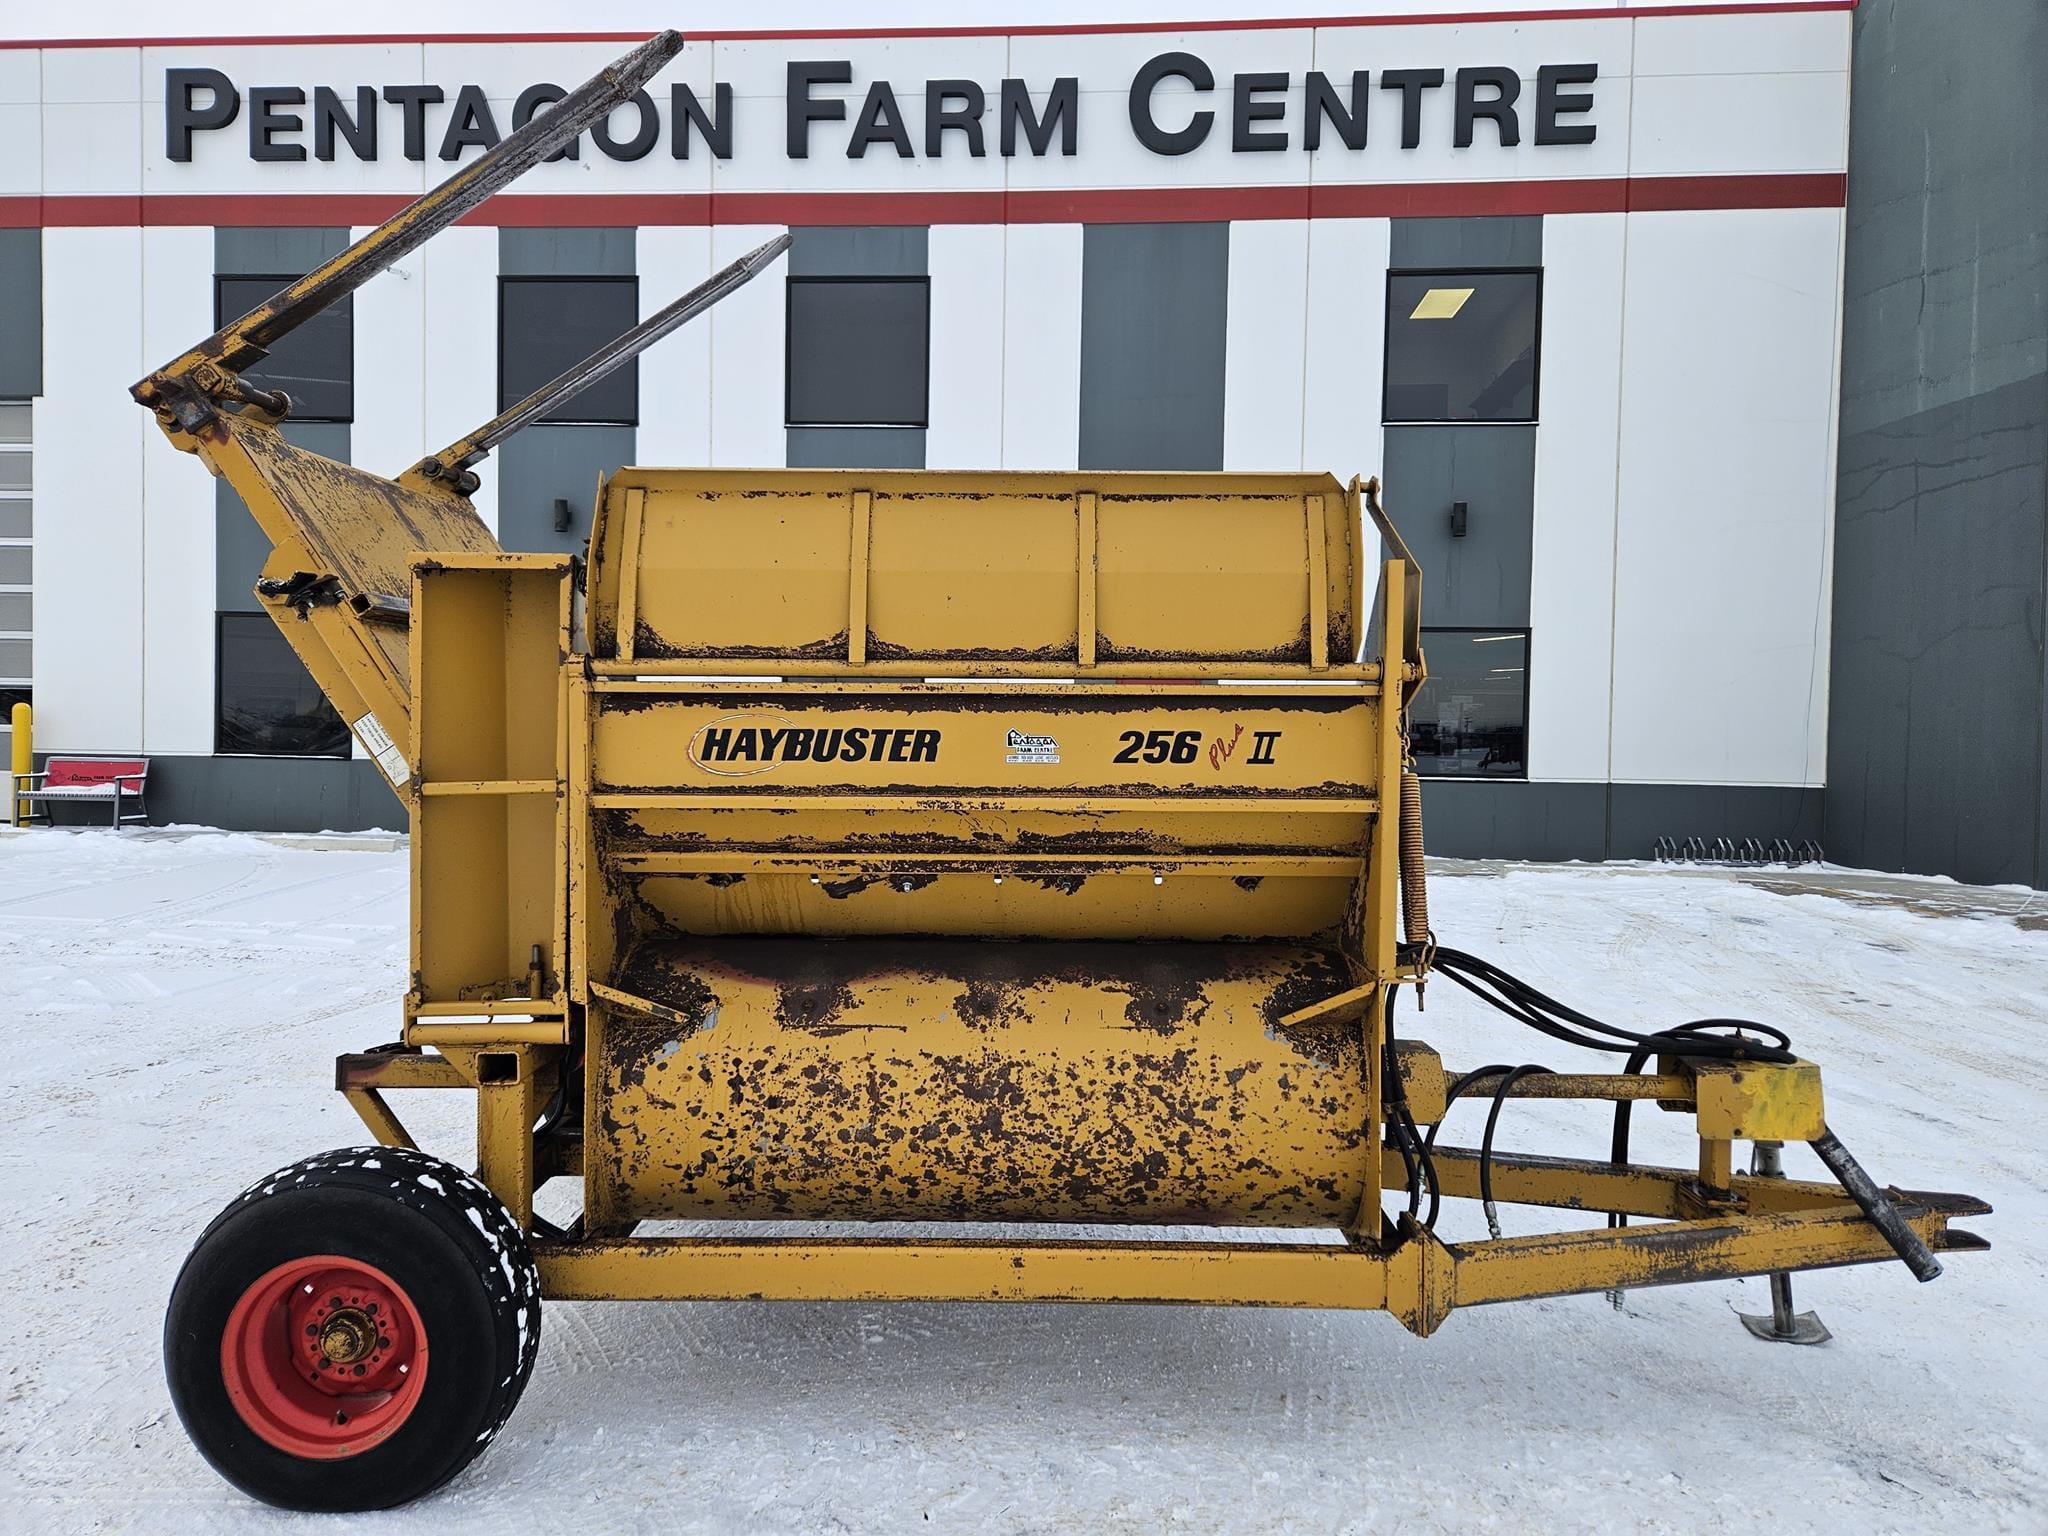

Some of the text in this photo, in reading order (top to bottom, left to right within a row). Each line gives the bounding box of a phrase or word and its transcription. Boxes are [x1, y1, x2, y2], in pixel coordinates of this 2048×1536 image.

[786, 59, 1079, 160] FARM
[1129, 52, 1599, 157] CENTRE
[701, 728, 941, 763] HAYBUSTER
[1113, 723, 1283, 772] 256 Plus II
